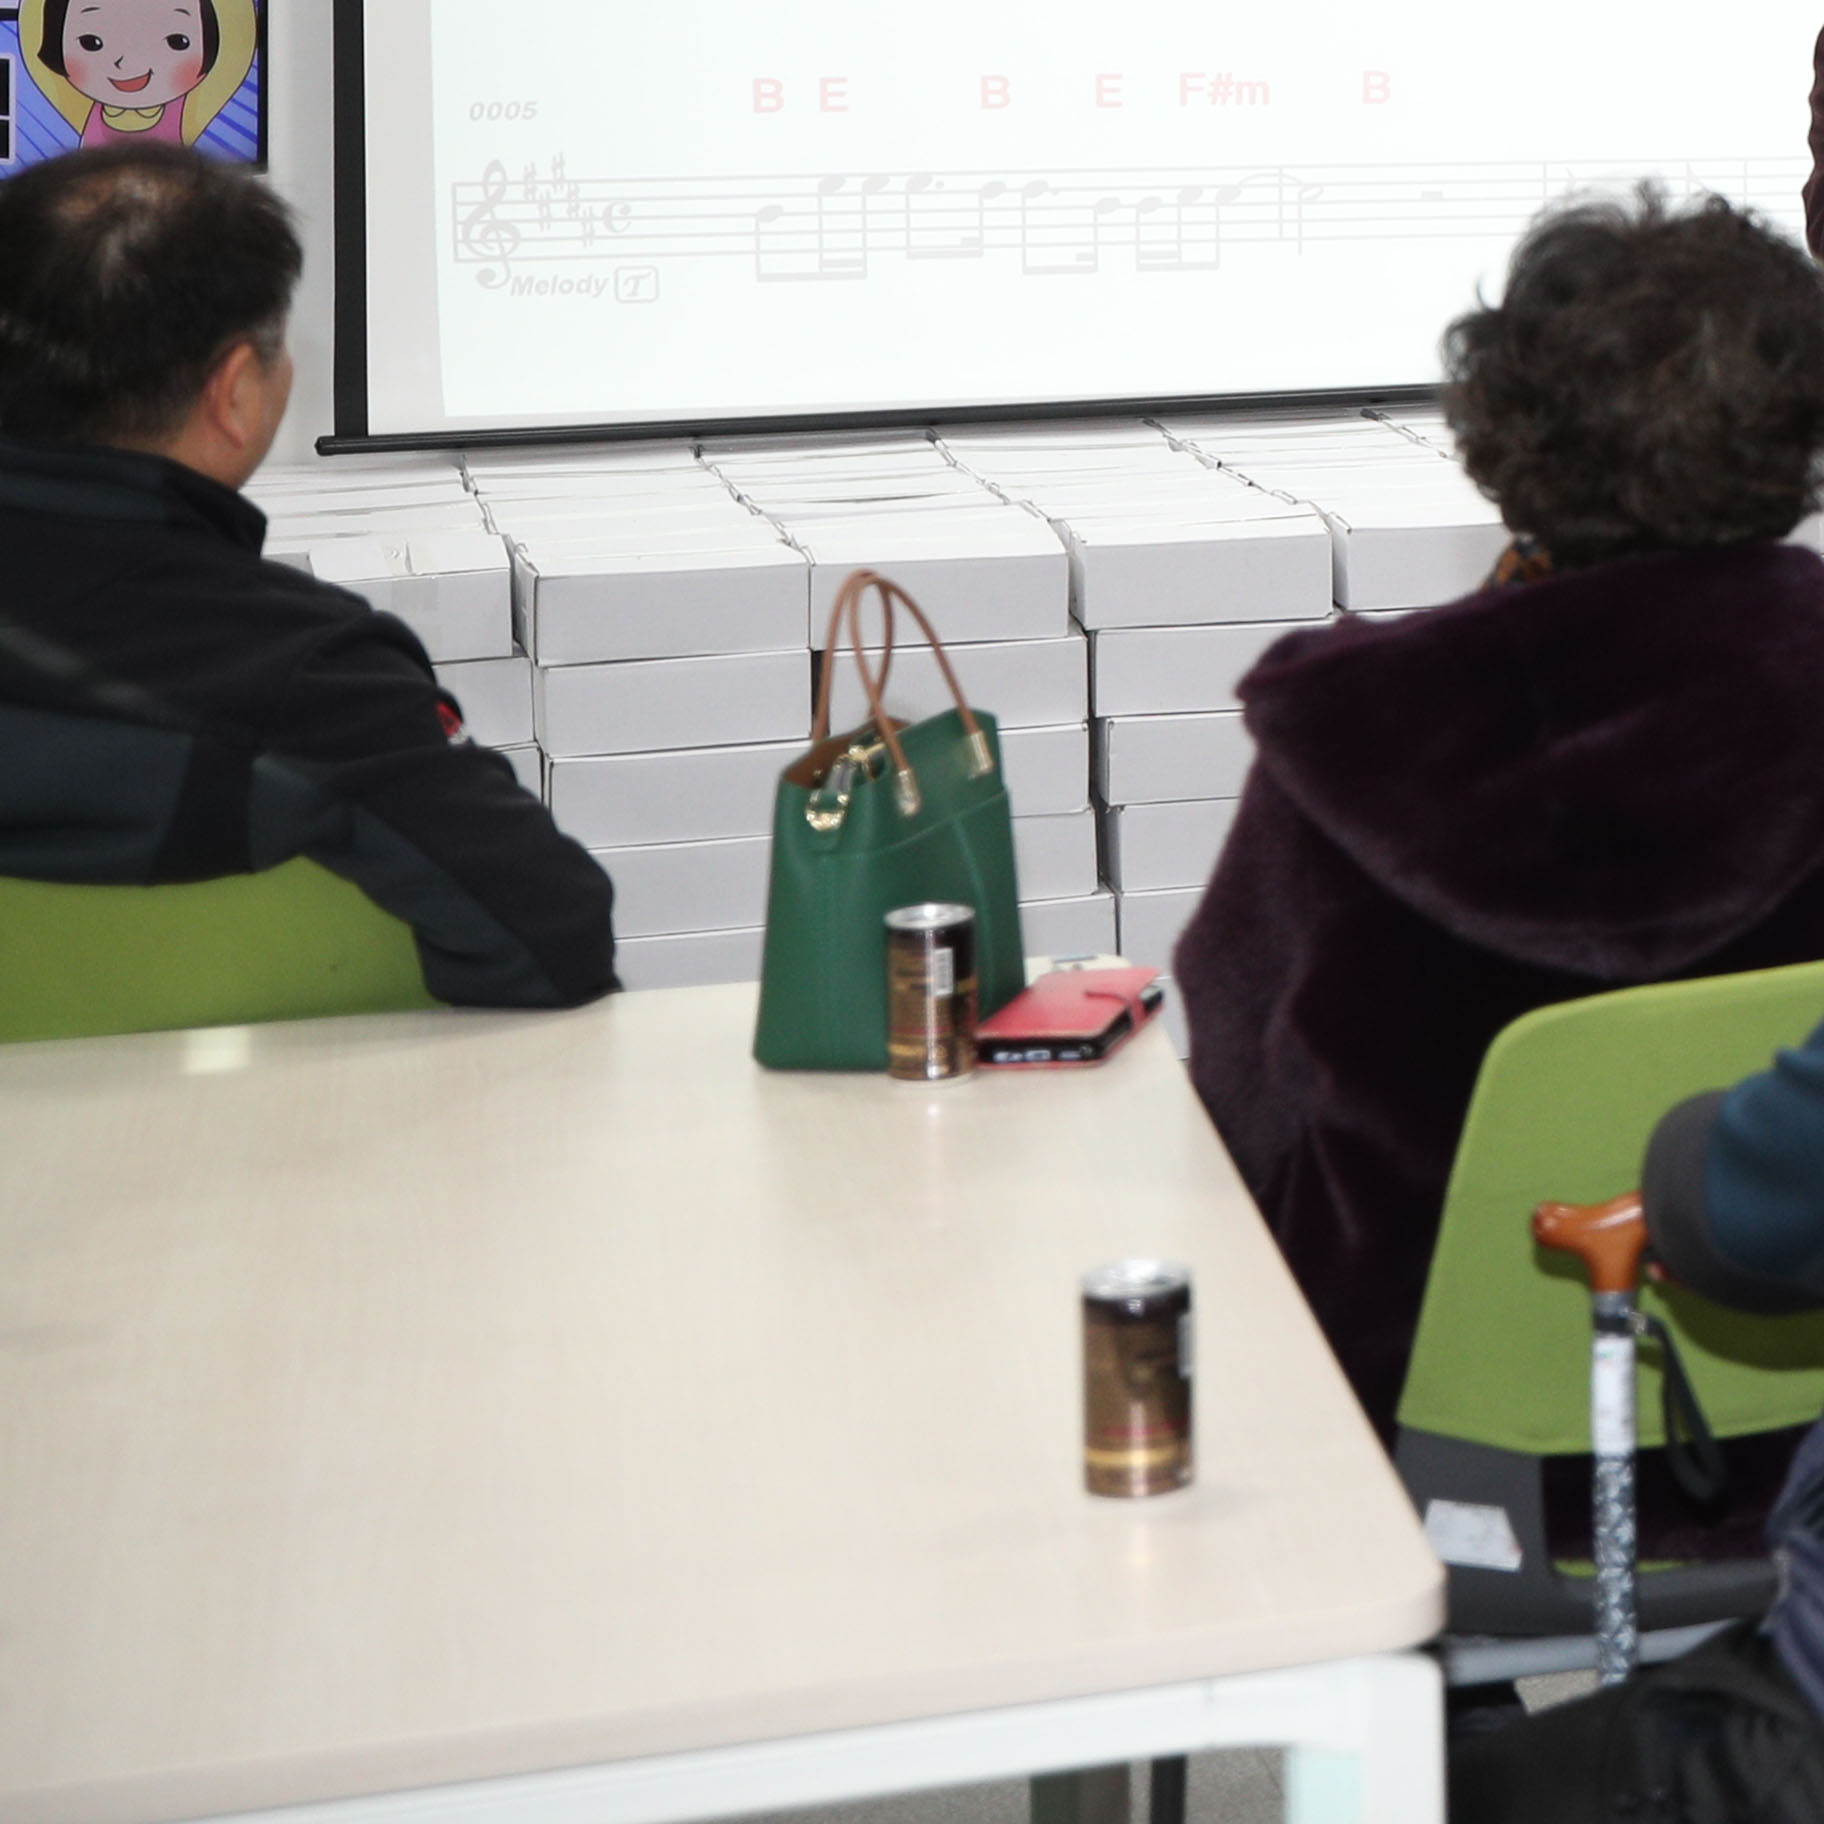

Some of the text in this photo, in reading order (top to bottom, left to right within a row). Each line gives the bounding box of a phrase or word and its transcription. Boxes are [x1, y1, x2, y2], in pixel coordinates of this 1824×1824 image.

[753, 78, 786, 115] B
[819, 77, 850, 114] E
[980, 76, 1012, 111] B
[1095, 74, 1124, 109] E
[1179, 71, 1271, 108] F#m
[1362, 70, 1393, 106] B
[469, 101, 541, 123] 0005
[507, 265, 611, 301] Melody
